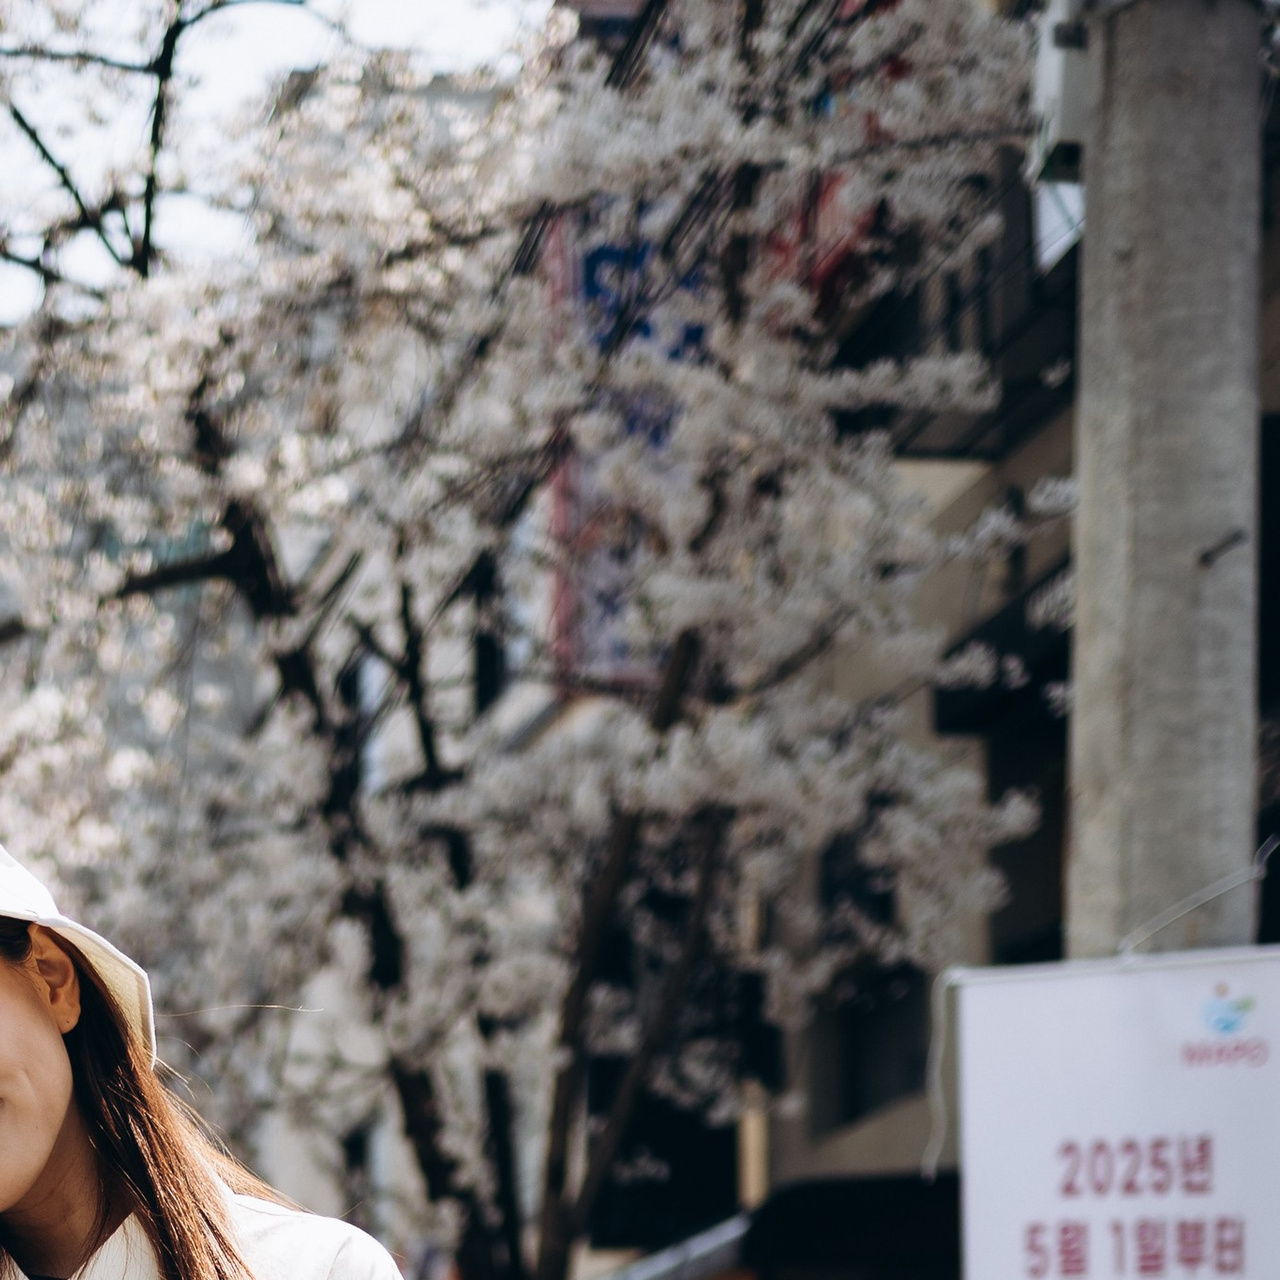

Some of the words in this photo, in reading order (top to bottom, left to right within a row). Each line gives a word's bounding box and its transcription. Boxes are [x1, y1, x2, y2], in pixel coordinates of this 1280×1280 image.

[1056, 1134, 1213, 1196] 2025년
[1024, 1219, 1088, 1279] 5월
[1109, 1217, 1244, 1278] 1일부터
